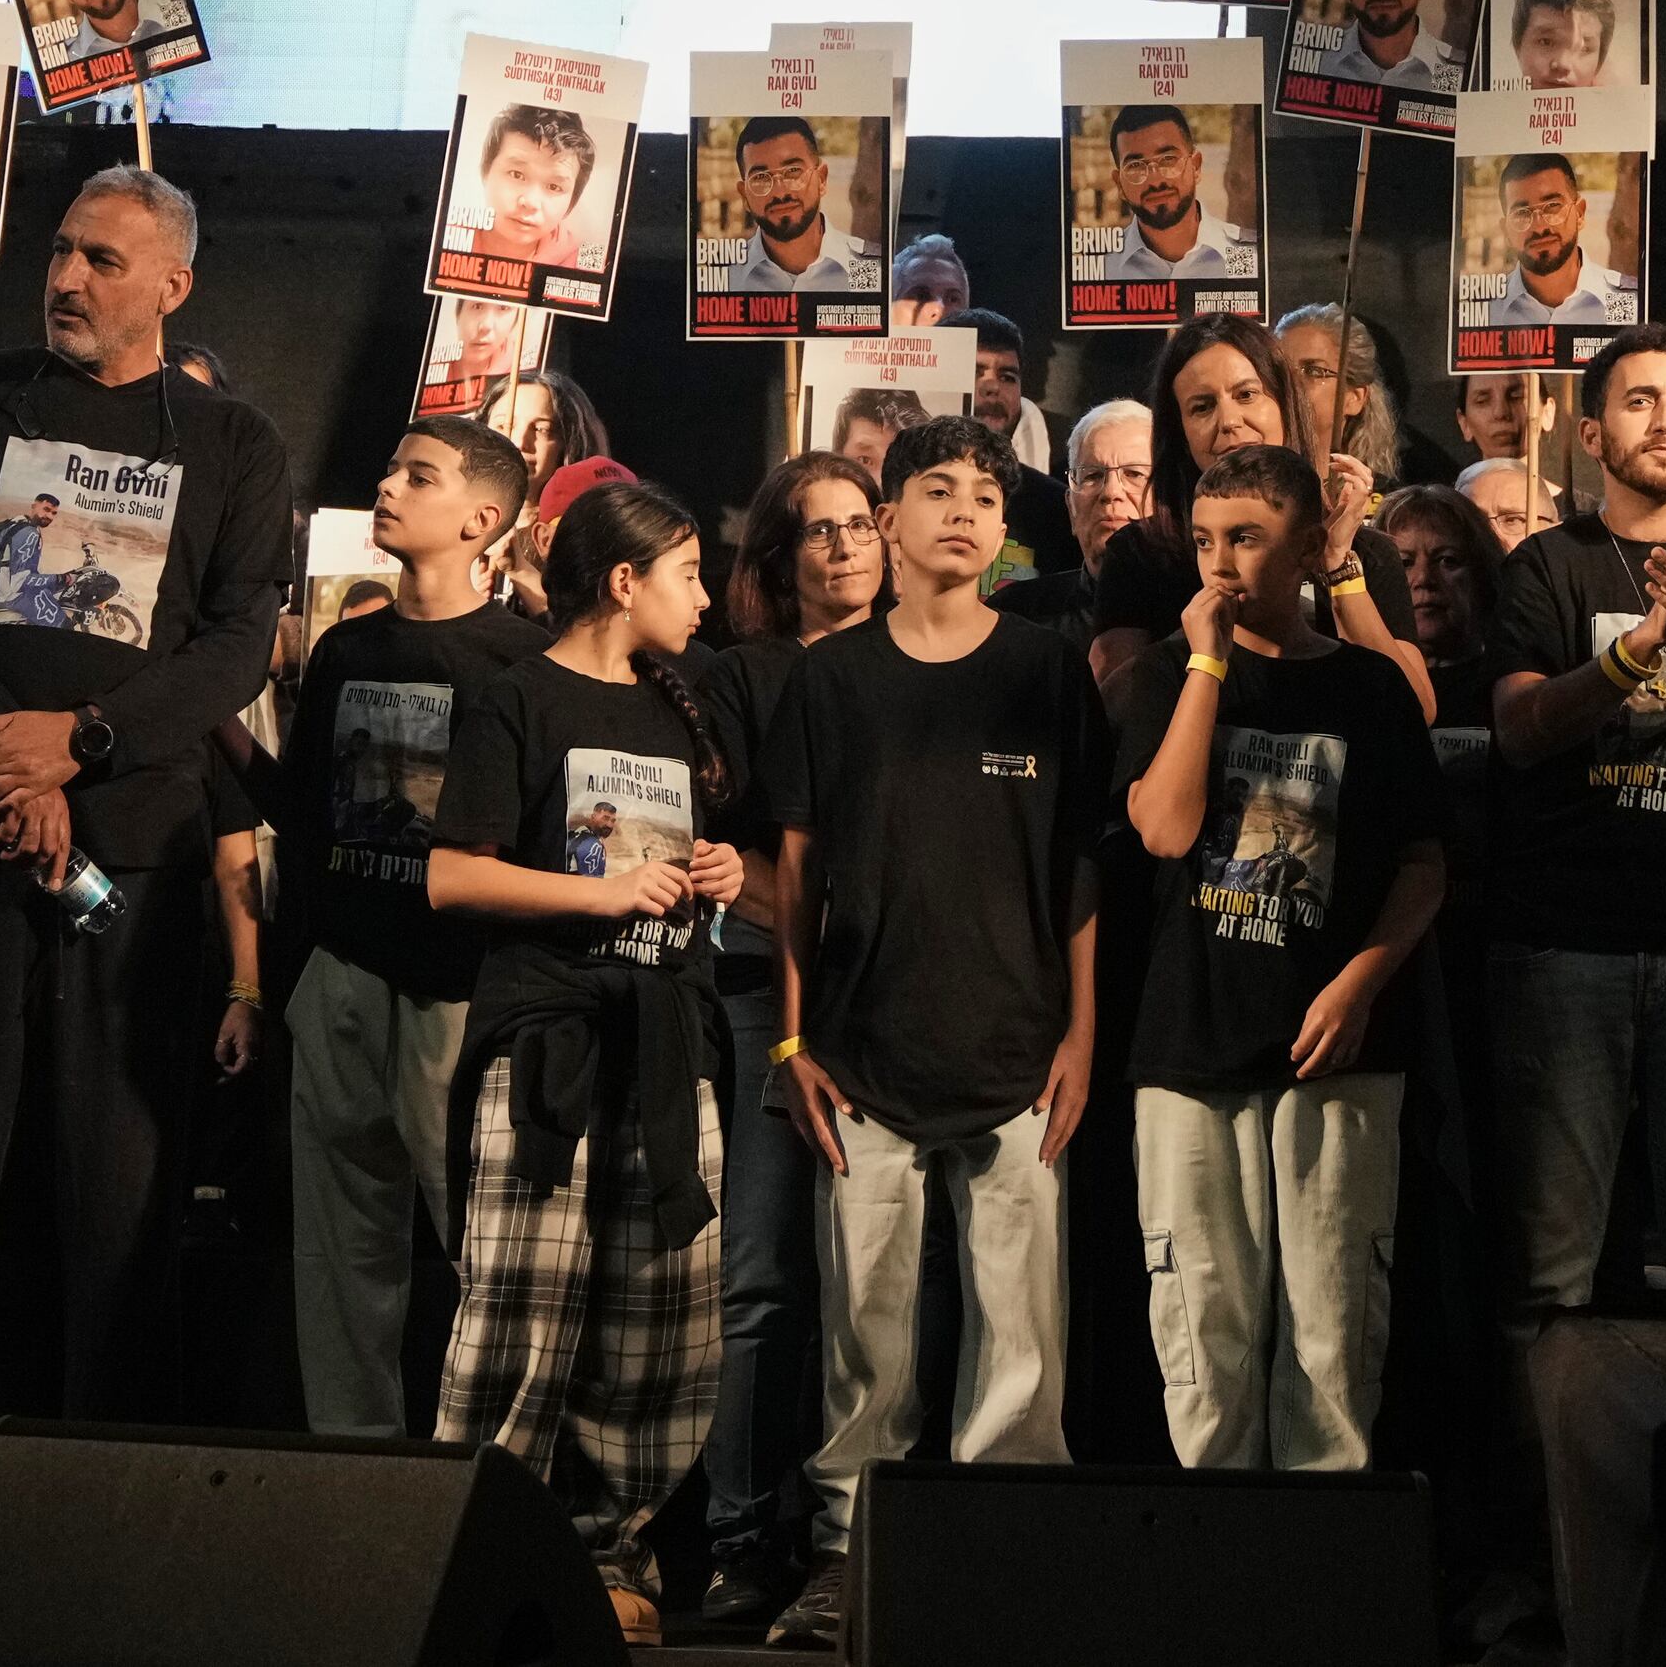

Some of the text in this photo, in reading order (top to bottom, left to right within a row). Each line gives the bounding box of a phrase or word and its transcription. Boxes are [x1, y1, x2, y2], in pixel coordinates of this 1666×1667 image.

[31, 16, 79, 50] BRING
[1292, 21, 1344, 53] BRING
[37, 43, 70, 71] HIM
[771, 59, 801, 73] גואילי
[1143, 47, 1173, 61] גואילי
[1288, 47, 1322, 75] HIM
[504, 66, 606, 94] SUDTHISAK RINTHALAK
[768, 76, 816, 90] RAN GVILI
[1140, 64, 1189, 78] RAN GVILI
[543, 86, 562, 103] (43)
[782, 92, 802, 108] (24)
[1154, 80, 1175, 97] (24)
[447, 203, 495, 231] BRING
[442, 225, 475, 252] HIM
[1072, 227, 1124, 254] BRING
[697, 239, 747, 265] BRING
[439, 253, 533, 288] HOME NOW!
[697, 267, 729, 292] HIM
[1072, 256, 1105, 281] HIM
[543, 283, 601, 302] FAMILIES FORUM
[1074, 281, 1175, 312] HOME NOW!
[1459, 274, 1507, 300] BRING
[697, 293, 797, 322] HOME NOW!
[1195, 300, 1259, 313] FAMILIES FORUM
[1458, 302, 1489, 326] HIM
[817, 314, 881, 326] FAMILIES FORUM
[1458, 327, 1554, 356] HOME NOW!
[64, 453, 109, 492] Ran
[74, 492, 164, 520] Alumim's Shield
[27, 576, 48, 586] FOX
[1249, 734, 1309, 760] RAN GVILI
[611, 757, 663, 784] RAN GVILI
[1286, 762, 1328, 784] SHIELD
[1588, 764, 1655, 787] WAITING
[646, 784, 682, 808] SHIELD
[1616, 785, 1638, 807] AT
[380, 853, 427, 885] חכים
[1256, 893, 1289, 921] FOR
[1294, 899, 1325, 930] YOU
[632, 919, 664, 945] FOR
[665, 924, 692, 950] YOU
[1216, 913, 1286, 947] AT HOME
[613, 939, 661, 966] HOME
